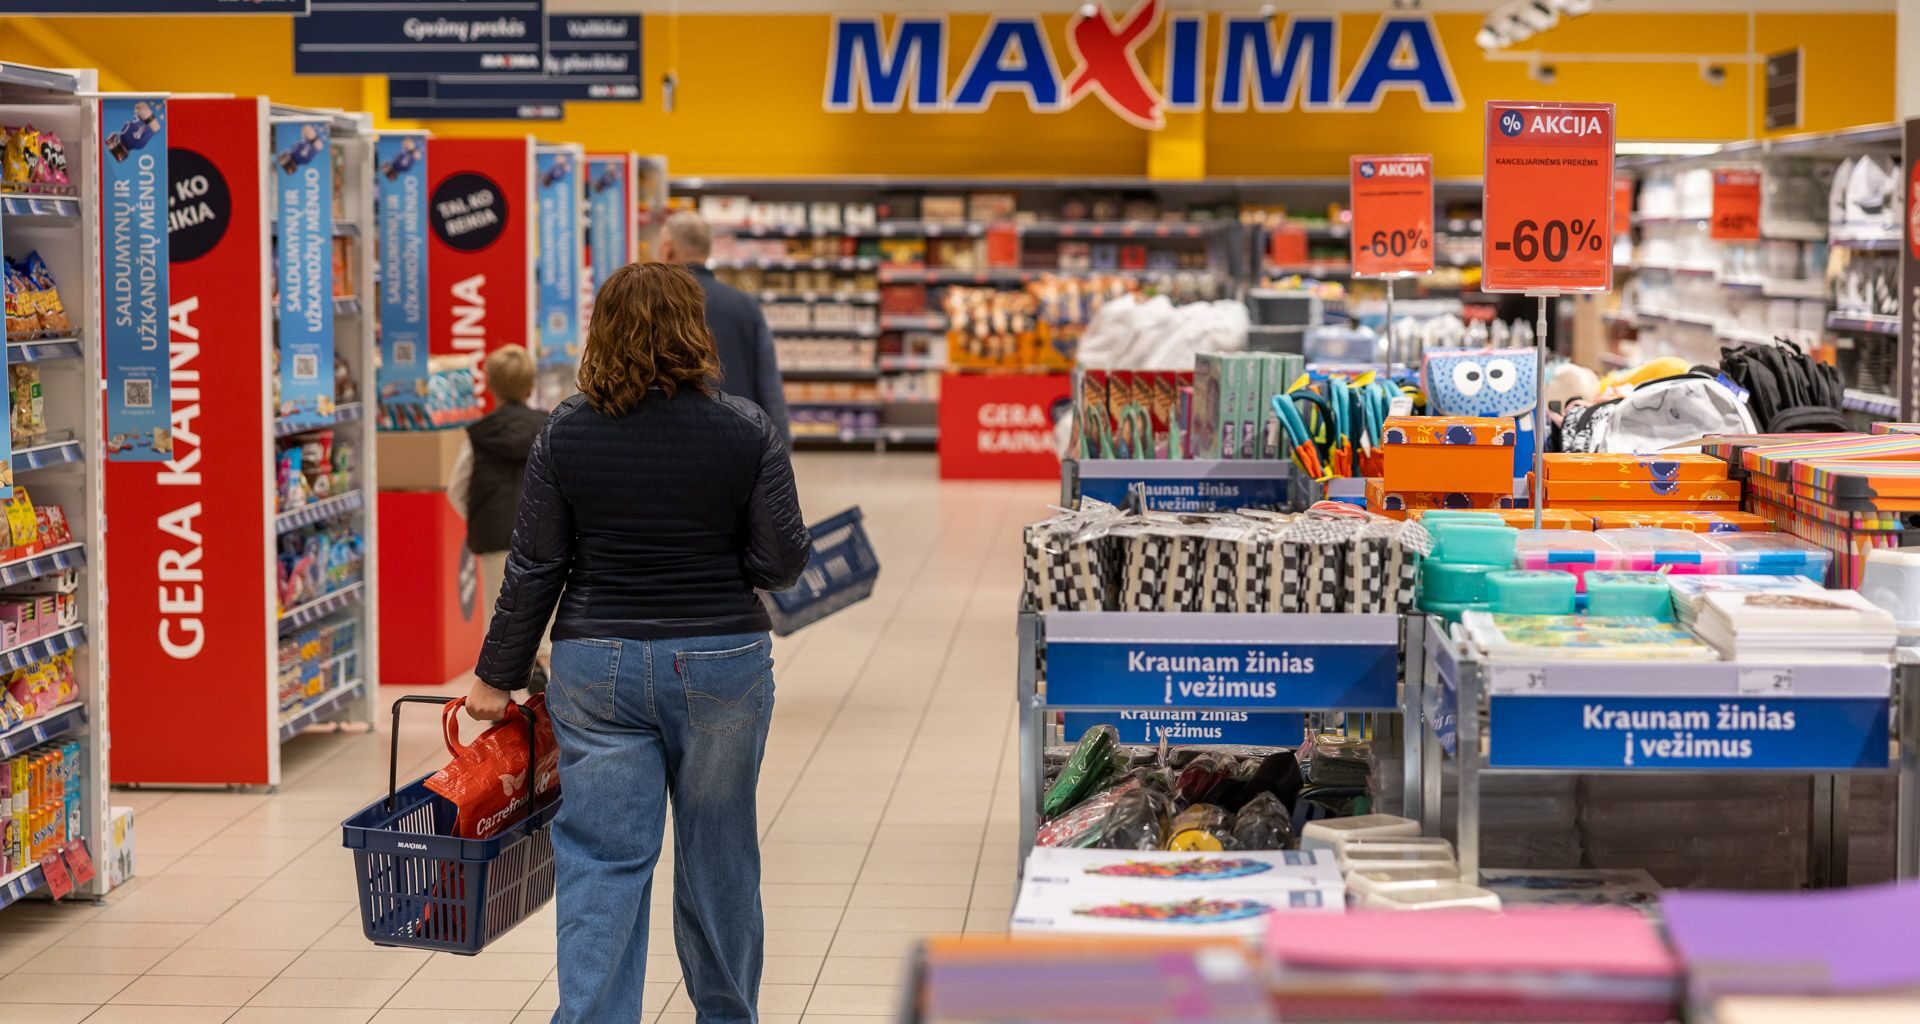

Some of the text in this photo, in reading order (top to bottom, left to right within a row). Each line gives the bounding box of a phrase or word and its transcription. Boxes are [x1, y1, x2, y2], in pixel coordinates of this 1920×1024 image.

[823, 0, 1464, 128] MAXIMA
[1530, 115, 1602, 137] AKCIJA
[1378, 163, 1425, 178] AKCIJA
[1562, 158, 1599, 167] PREKĖMS
[137, 154, 156, 231] MĖNUO
[176, 174, 209, 201] KO
[306, 167, 323, 229] MĖNUO
[167, 201, 216, 233] IKIA
[114, 179, 134, 327] SALDUMYNŲ IR
[285, 188, 302, 313] SALDUMYNŲ IR
[1360, 228, 1429, 258] -60%
[1495, 218, 1603, 263] -60%
[137, 233, 161, 351] UŽKANDŽIŲ
[978, 402, 1046, 429] GERA
[156, 295, 205, 660] GERA KAINA
[1128, 481, 1240, 497] Kaunam žinias
[1128, 649, 1315, 674] Kraunam žinias
[1164, 676, 1277, 705] į vežimus
[1582, 703, 1796, 731] Kraunam žinias
[1144, 722, 1222, 742] į vežimus
[1624, 732, 1753, 765] į vežimus
[397, 842, 428, 851] MAXIMA
